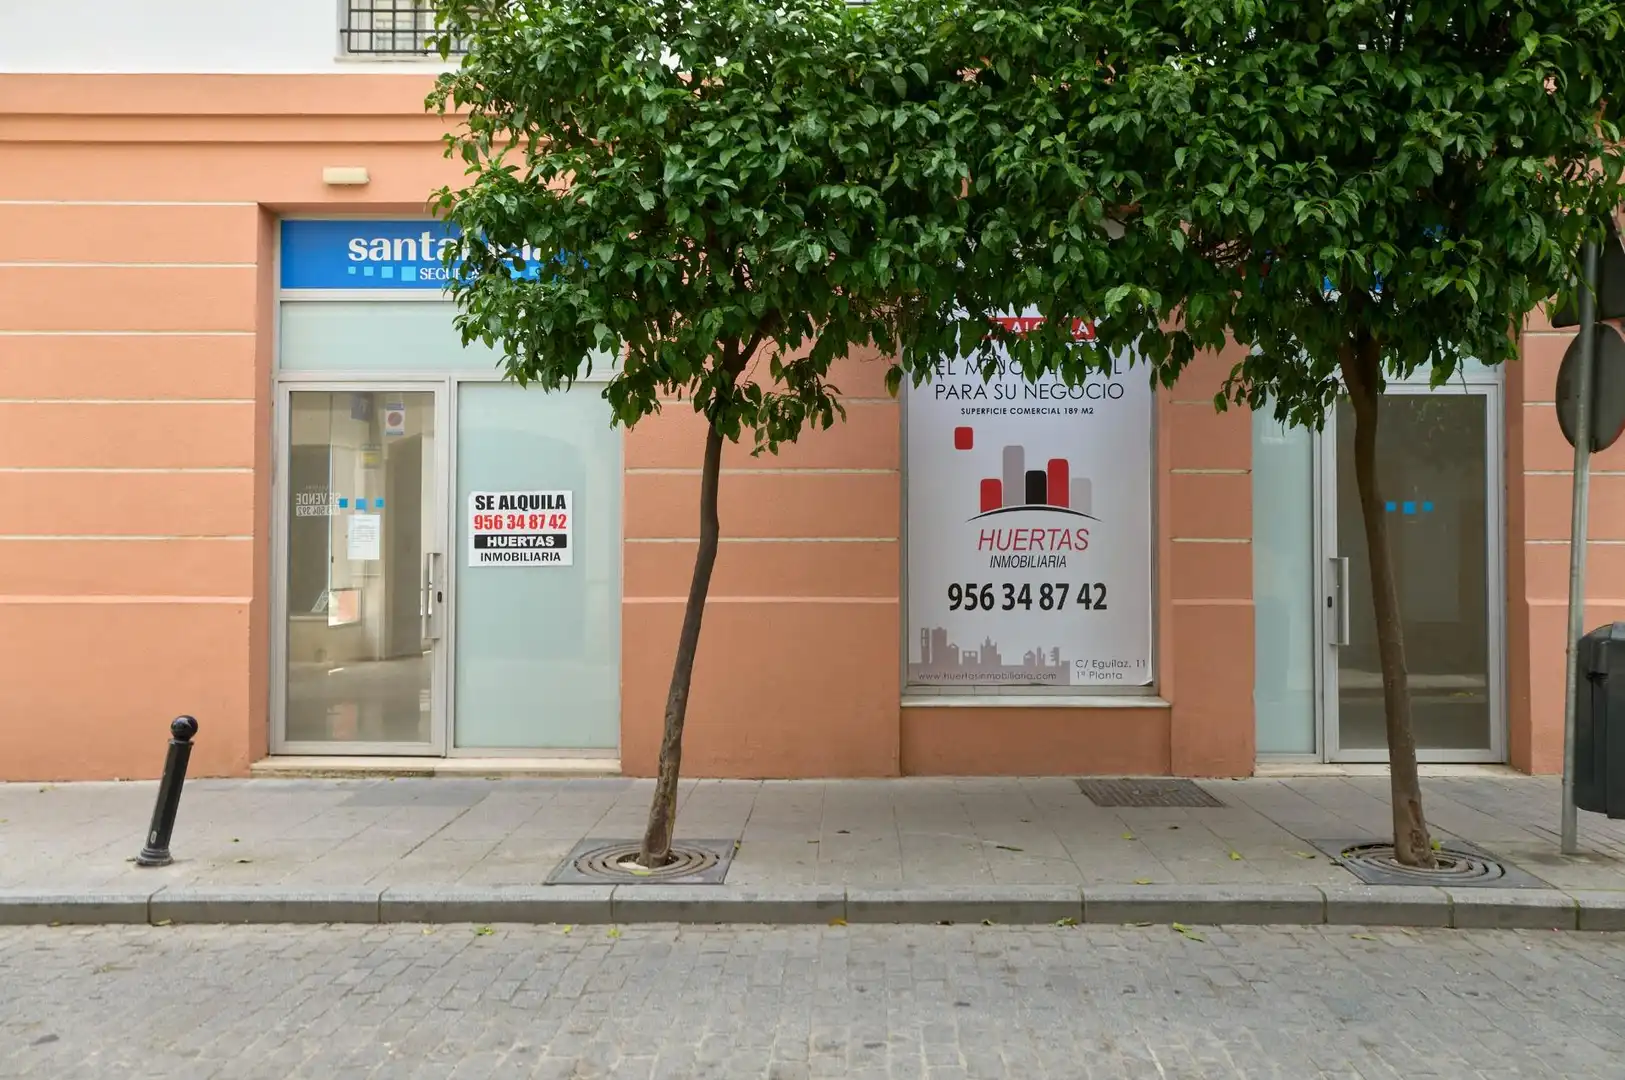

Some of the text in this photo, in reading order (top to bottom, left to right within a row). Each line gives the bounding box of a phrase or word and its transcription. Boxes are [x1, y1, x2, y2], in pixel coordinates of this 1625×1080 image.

[935, 359, 956, 376] EL
[935, 383, 1124, 400] PARA SU NEGOCIO
[960, 407, 1007, 415] SUPERFICIE
[1010, 407, 1061, 415] COMERCIAL
[1064, 407, 1079, 415] 189
[475, 494, 566, 512] SE ALQUILA
[474, 514, 567, 530] 956 34 87 42
[486, 536, 555, 547] HUERTAS
[978, 529, 1089, 551] HUERTAS
[990, 554, 1067, 568] INMOBILIARIA
[947, 583, 1108, 611] 956 34 87 42
[1090, 670, 1123, 680] Planta
